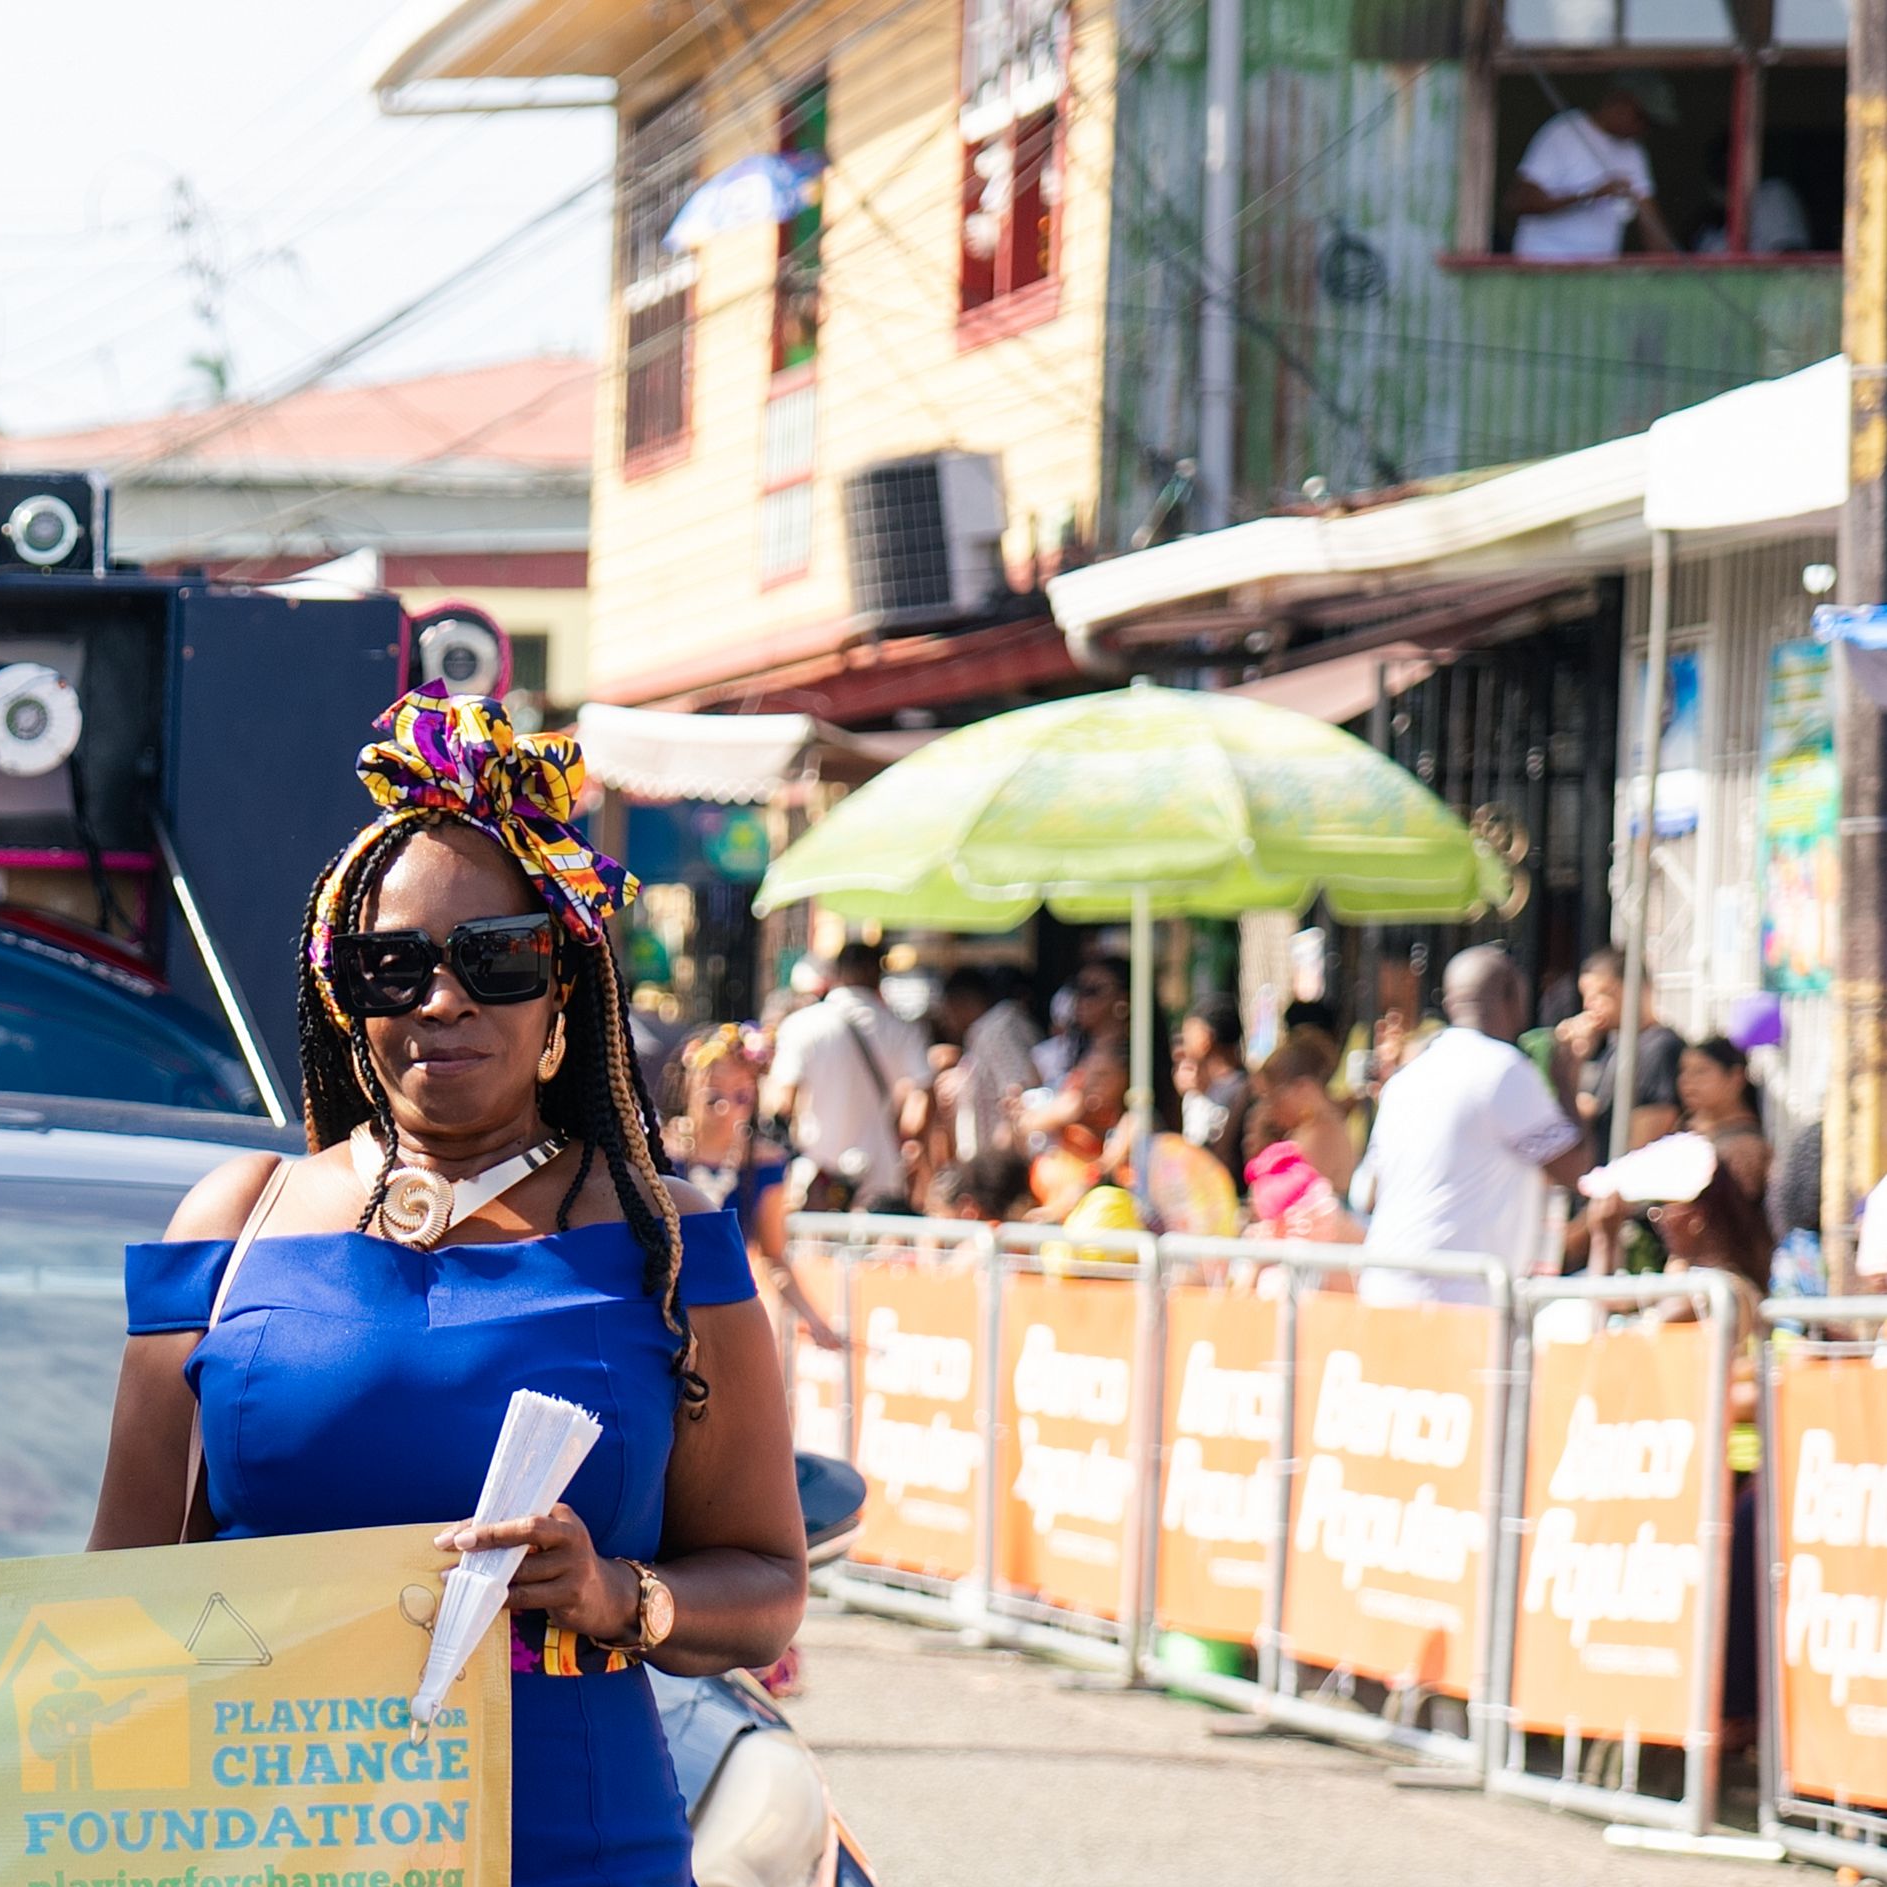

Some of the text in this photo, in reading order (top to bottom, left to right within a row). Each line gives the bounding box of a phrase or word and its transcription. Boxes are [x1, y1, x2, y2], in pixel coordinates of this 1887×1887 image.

[1313, 1349, 1473, 1469] Banco
[1295, 1453, 1488, 1591] Popular
[213, 1695, 412, 1736] PLAYING
[212, 1738, 469, 1789] CHANGE
[23, 1799, 469, 1856] FOUNDATION
